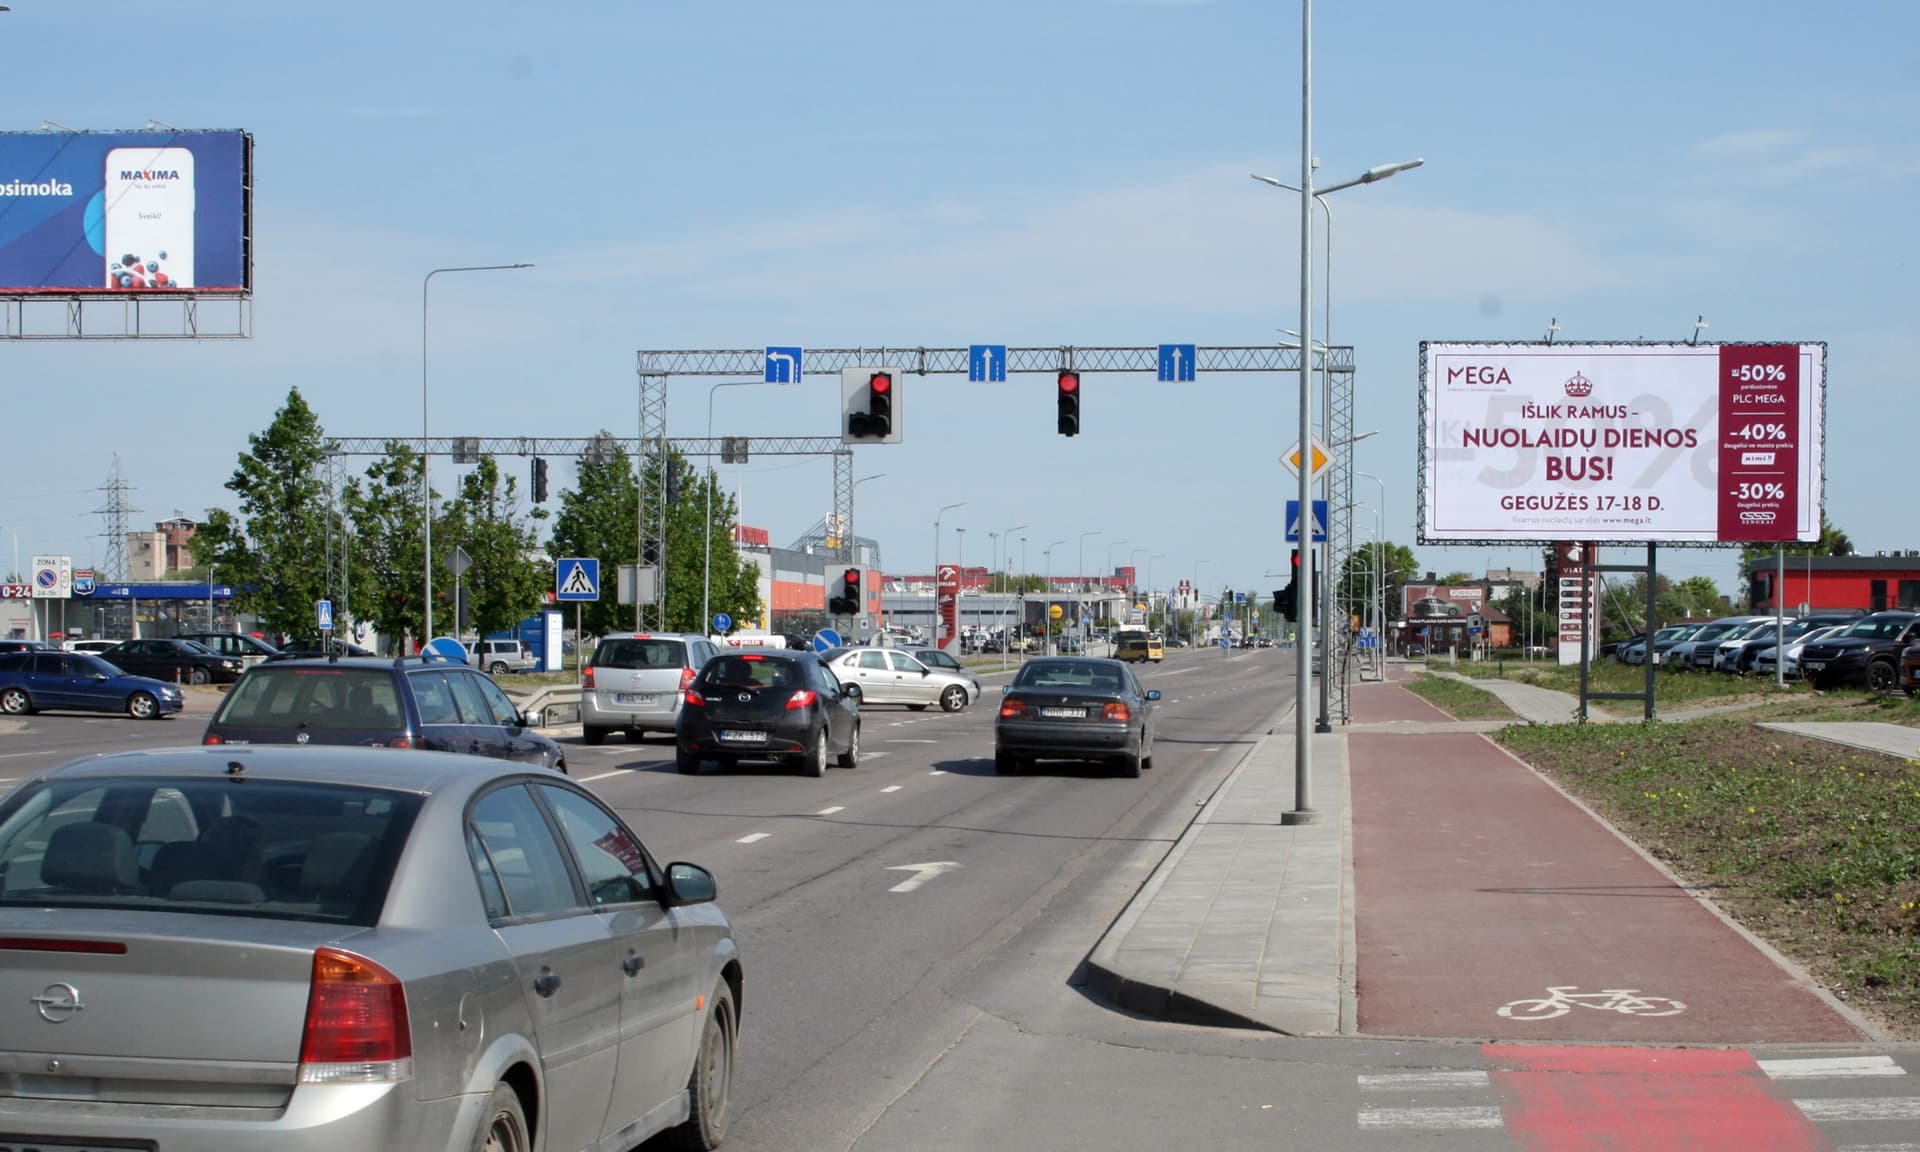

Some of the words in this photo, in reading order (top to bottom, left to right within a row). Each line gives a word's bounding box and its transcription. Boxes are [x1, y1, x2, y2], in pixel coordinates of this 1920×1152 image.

[121, 169, 179, 181] MAXIMA
[1447, 366, 1513, 386] MEGA
[1733, 394, 1752, 403] PLC
[1755, 394, 1785, 403] MEGA
[1521, 401, 1561, 419] IŠLIK
[1567, 404, 1627, 419] RAMUS
[1462, 427, 1597, 452] NUOLAIDŲ
[1604, 427, 1698, 449] DIENOS
[1729, 423, 1786, 440] -40%
[1545, 455, 1614, 482] BUS!
[1730, 482, 1785, 500] -30%
[1500, 491, 1589, 511] GEGUŽĖS
[1596, 495, 1642, 511] 17-18
[1647, 495, 1665, 511] D.
[1602, 516, 1652, 526] www.mega.lt
